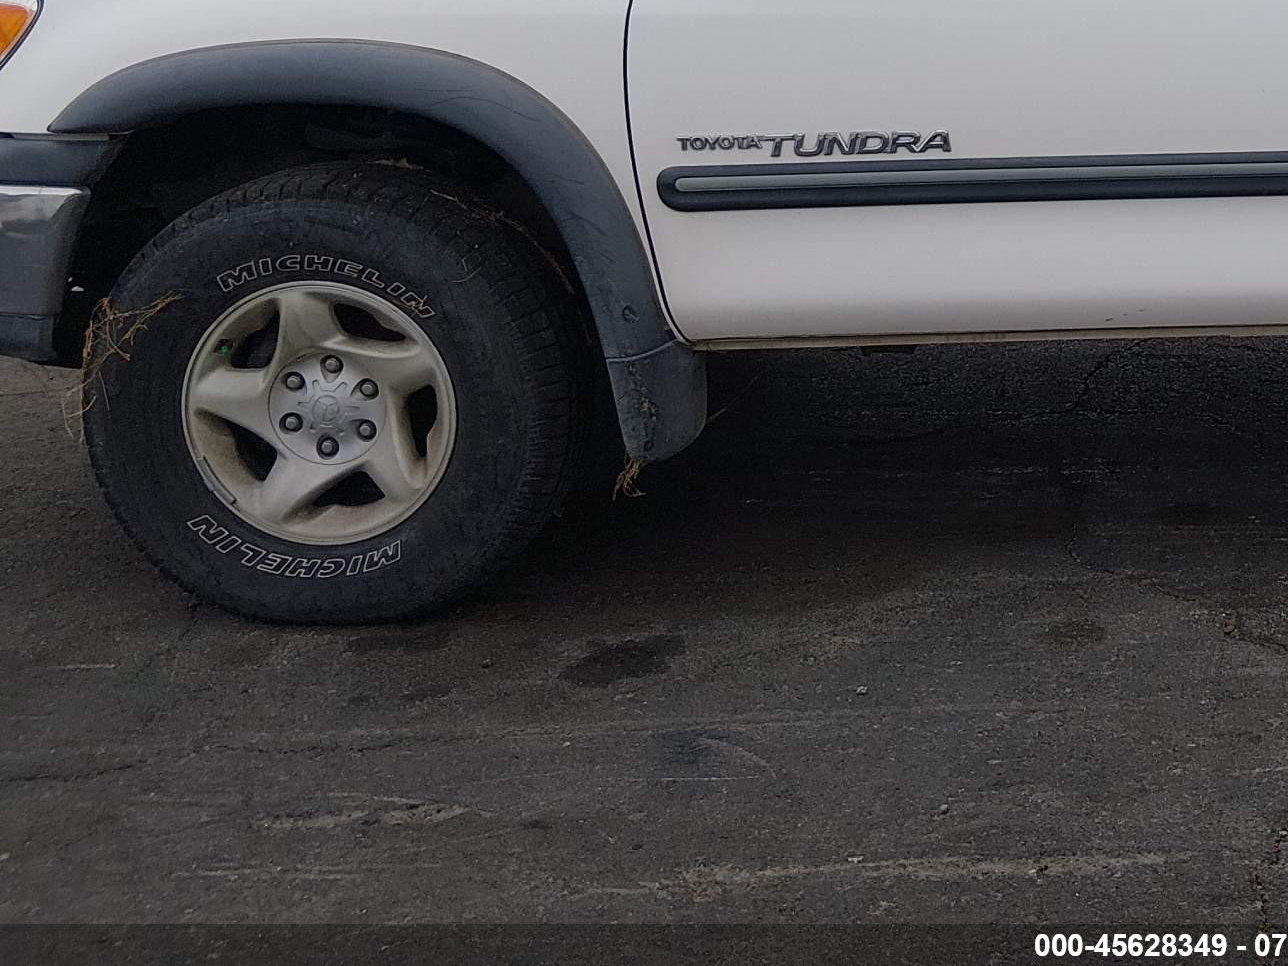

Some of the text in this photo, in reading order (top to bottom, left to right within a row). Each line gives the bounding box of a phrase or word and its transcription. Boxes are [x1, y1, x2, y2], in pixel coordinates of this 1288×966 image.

[676, 130, 952, 158] TOYOTA TUNDRA
[218, 254, 435, 319] MICHELIN
[188, 515, 401, 579] MICHELIN
